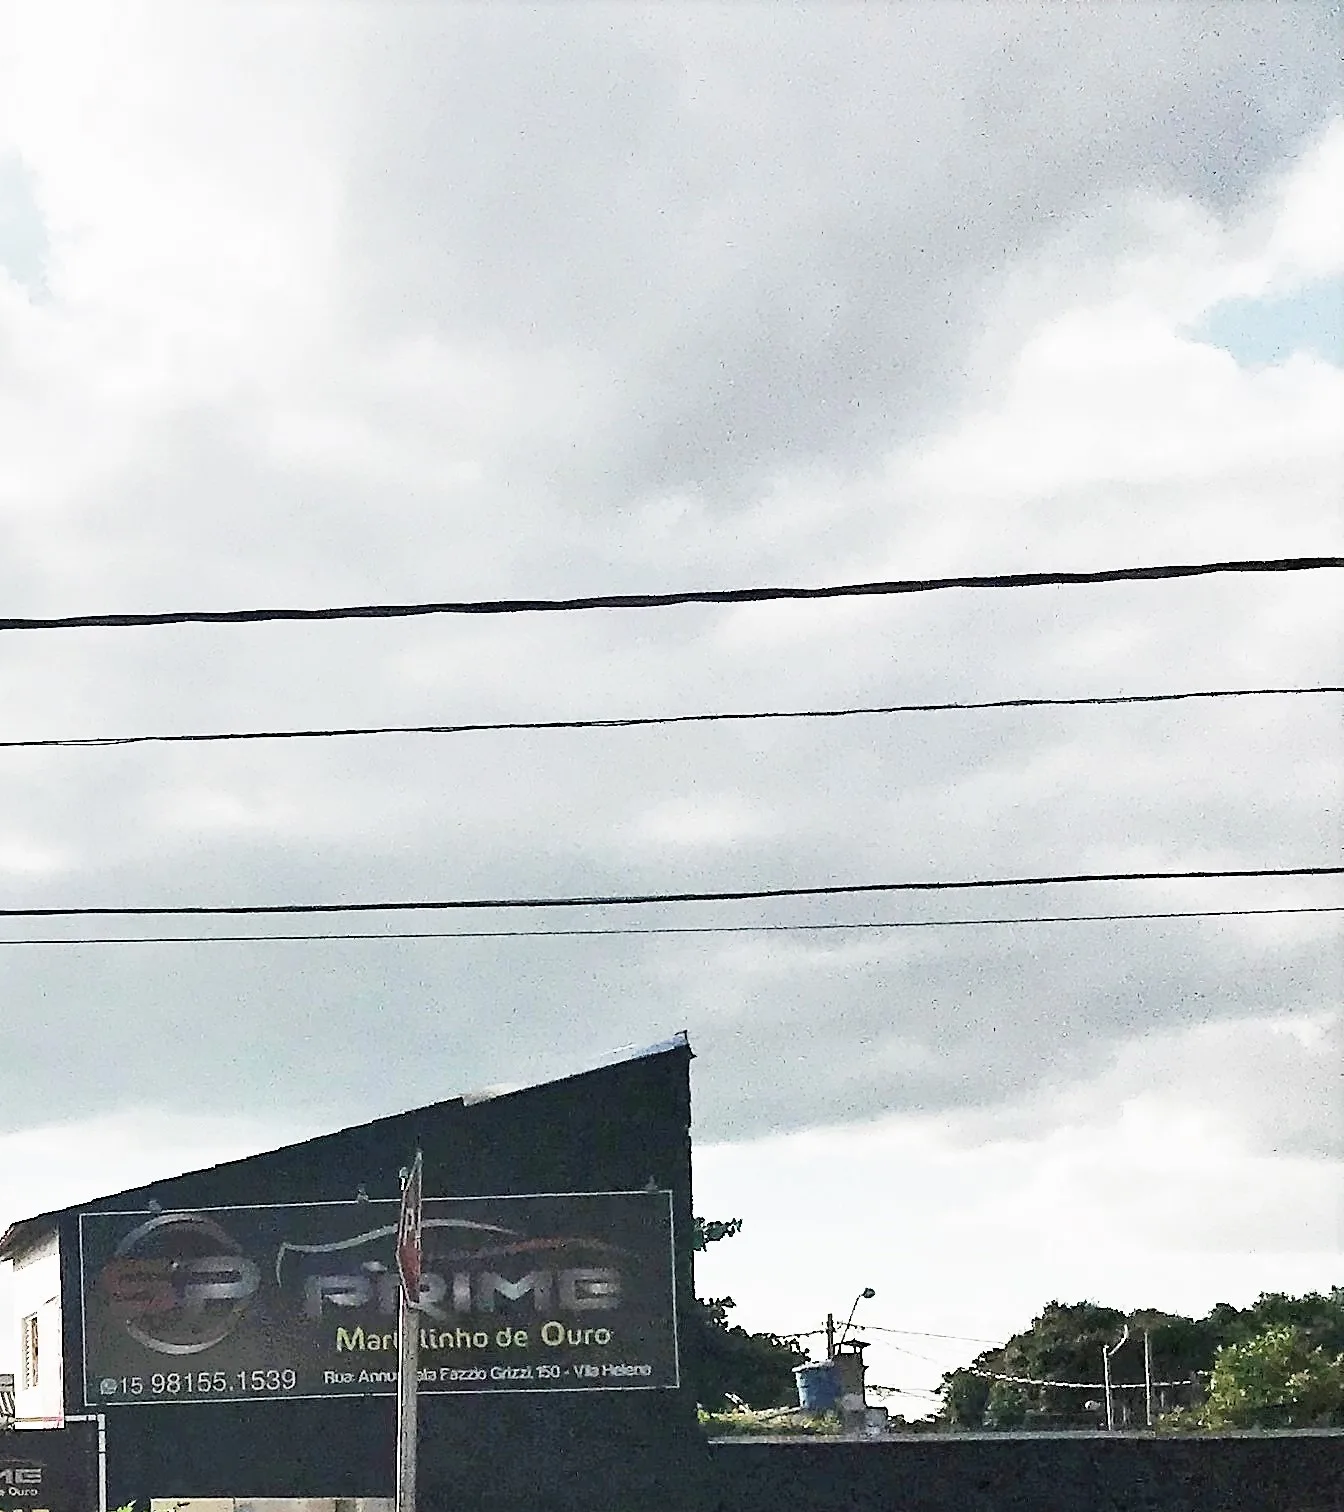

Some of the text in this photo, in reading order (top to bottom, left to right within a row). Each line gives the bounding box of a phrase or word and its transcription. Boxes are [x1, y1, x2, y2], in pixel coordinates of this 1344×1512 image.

[304, 1262, 622, 1320] PRIME
[496, 1327, 528, 1348] de
[541, 1320, 612, 1347] Ouro
[120, 1369, 297, 1394] 15 98155.1539
[573, 1364, 600, 1379] Vila
[8, 1486, 39, 1497] Ouro
